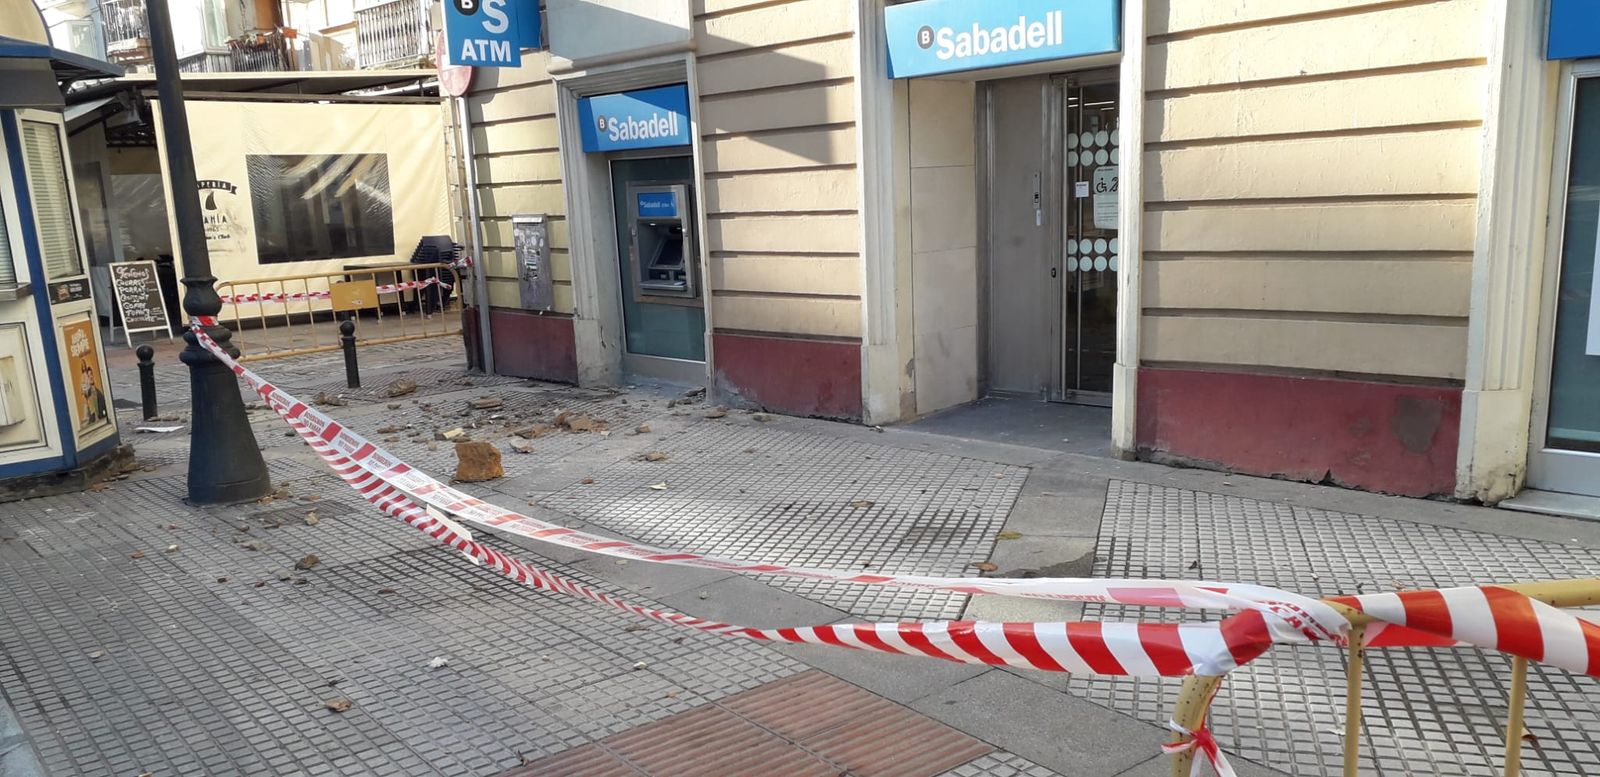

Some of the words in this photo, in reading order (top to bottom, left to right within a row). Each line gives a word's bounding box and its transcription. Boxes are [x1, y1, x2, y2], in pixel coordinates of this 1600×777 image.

[482, 0, 509, 34] S
[461, 38, 512, 63] ATM
[920, 30, 930, 45] B
[935, 10, 1063, 61] Sabadell
[608, 111, 679, 142] Sabadell
